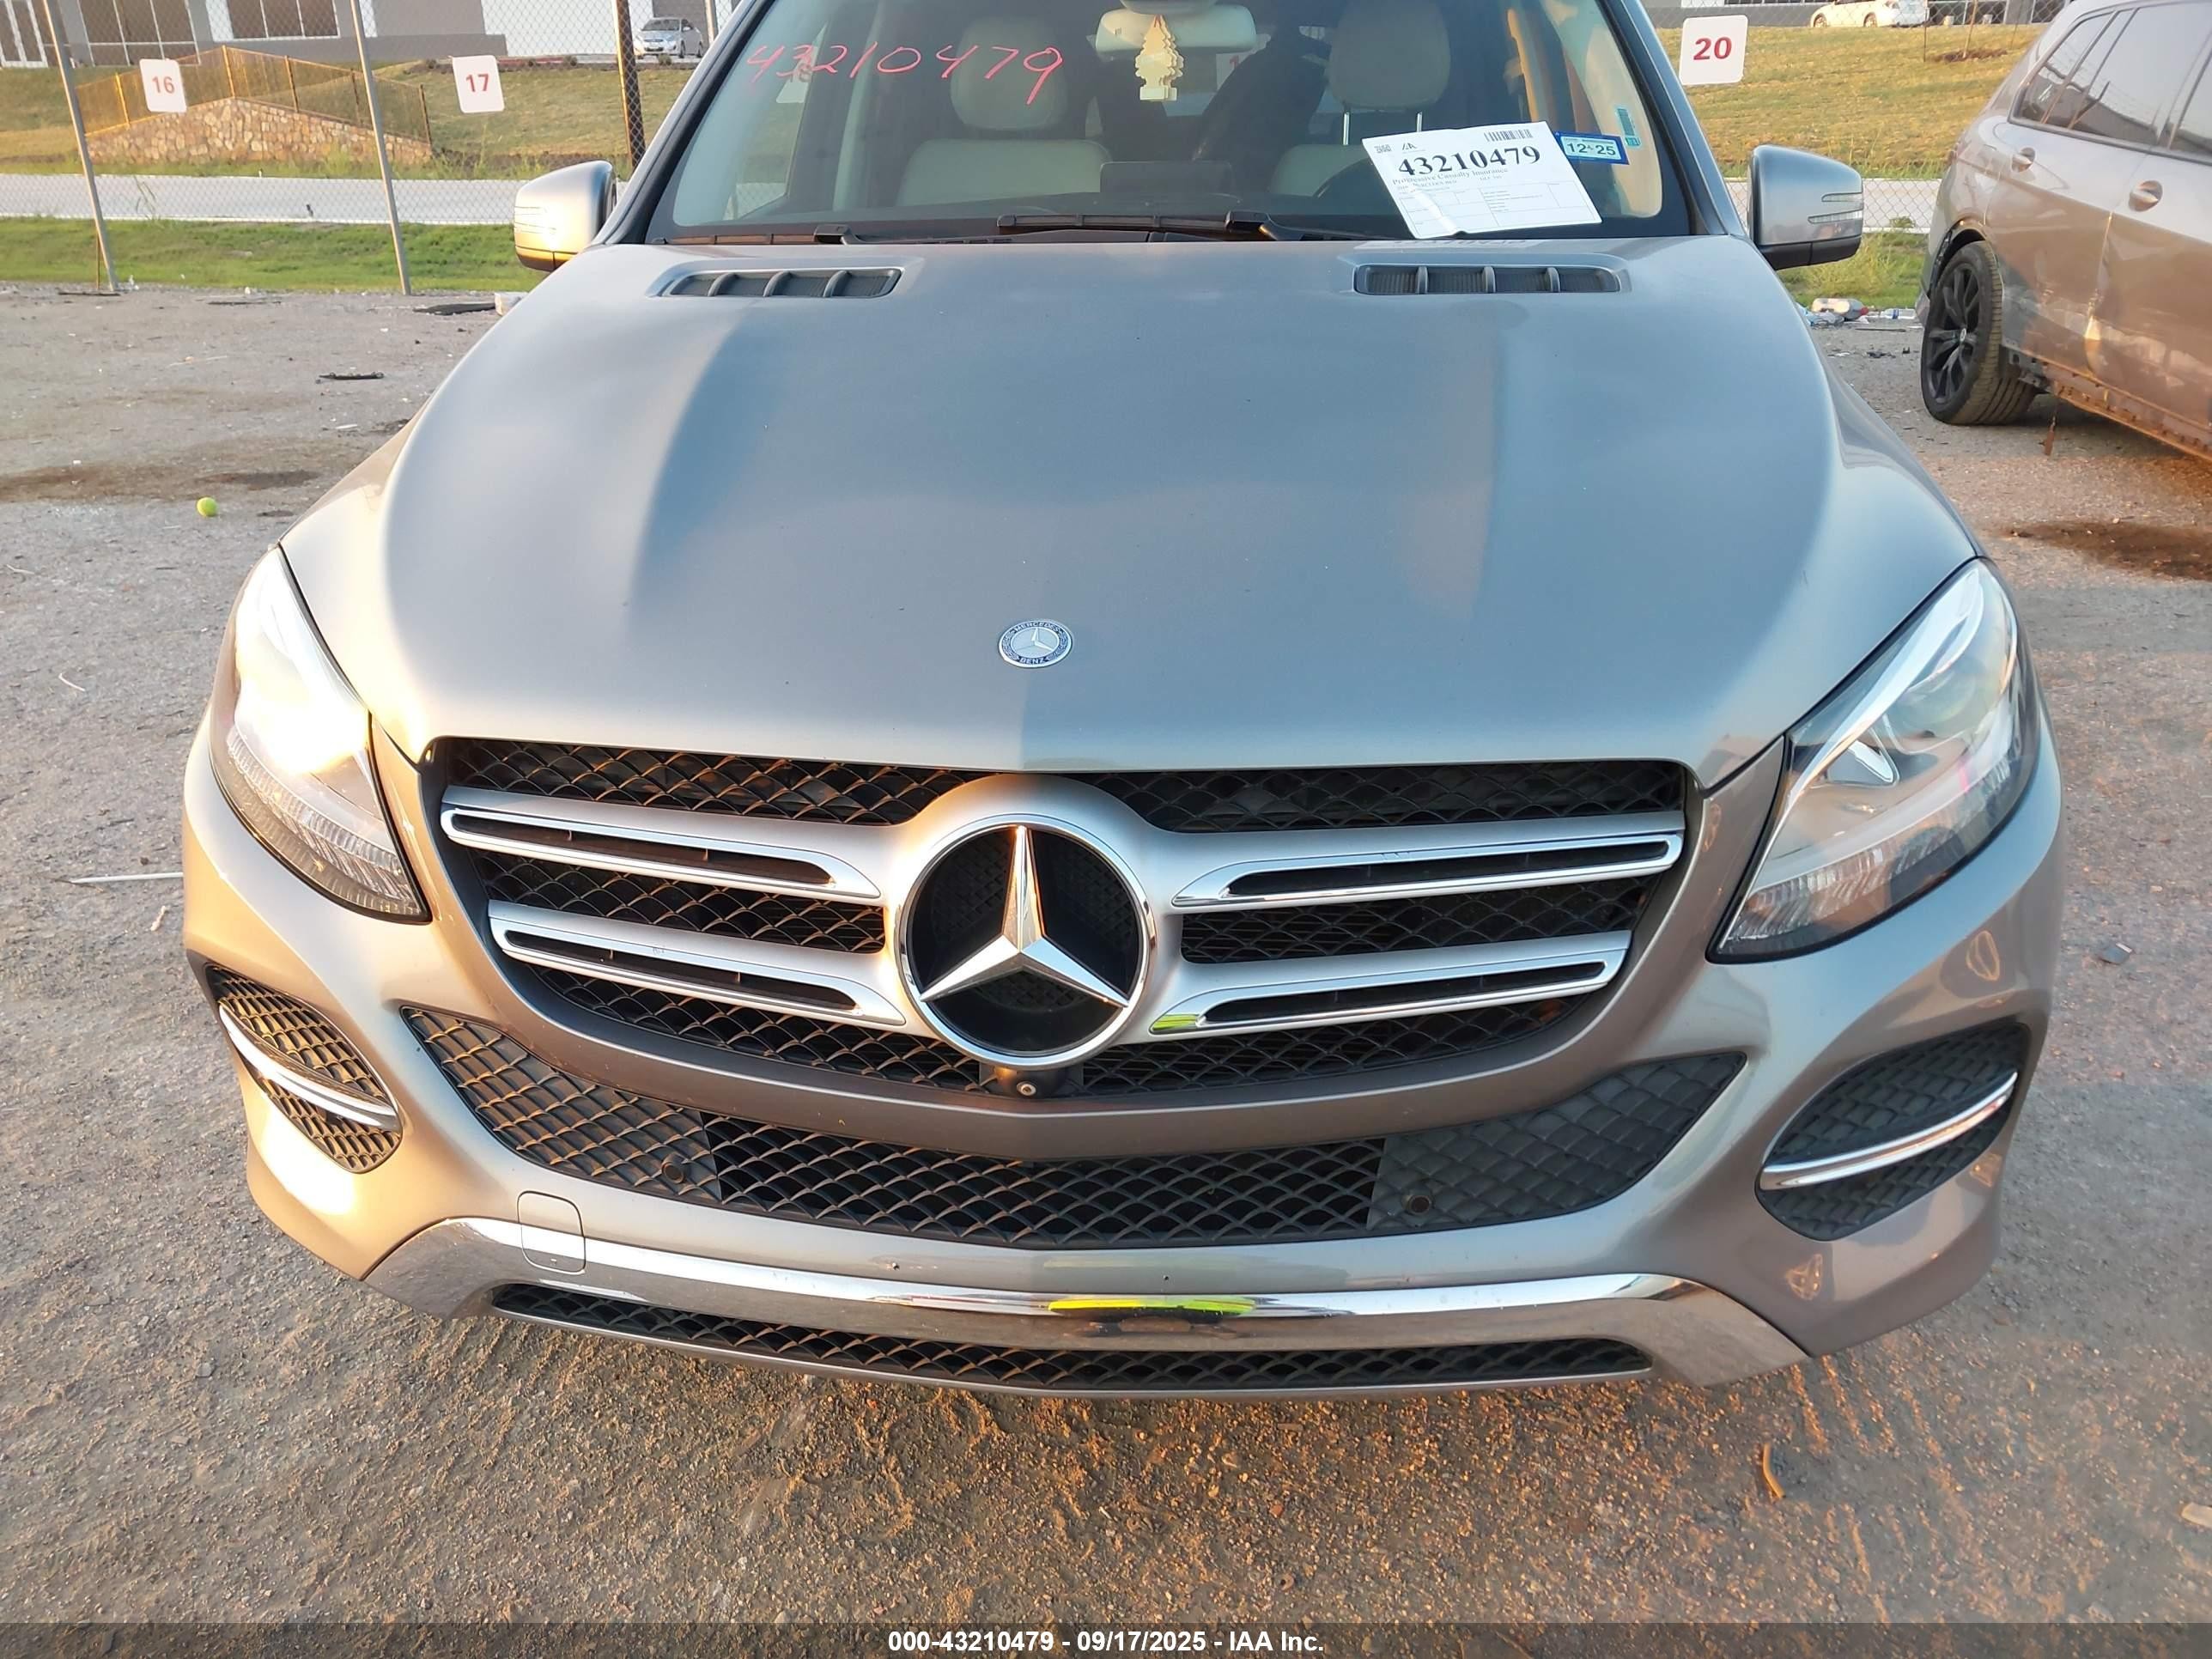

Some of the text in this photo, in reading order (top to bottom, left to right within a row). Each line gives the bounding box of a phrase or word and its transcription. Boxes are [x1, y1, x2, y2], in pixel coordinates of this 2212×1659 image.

[1693, 36, 1732, 60] 20
[746, 41, 1064, 105] 43210479
[152, 76, 175, 94] 16
[465, 74, 489, 92] 17
[1567, 143, 1616, 155] 12 25
[1398, 145, 1540, 176] 43210479
[1014, 621, 1060, 633] MERCEDES
